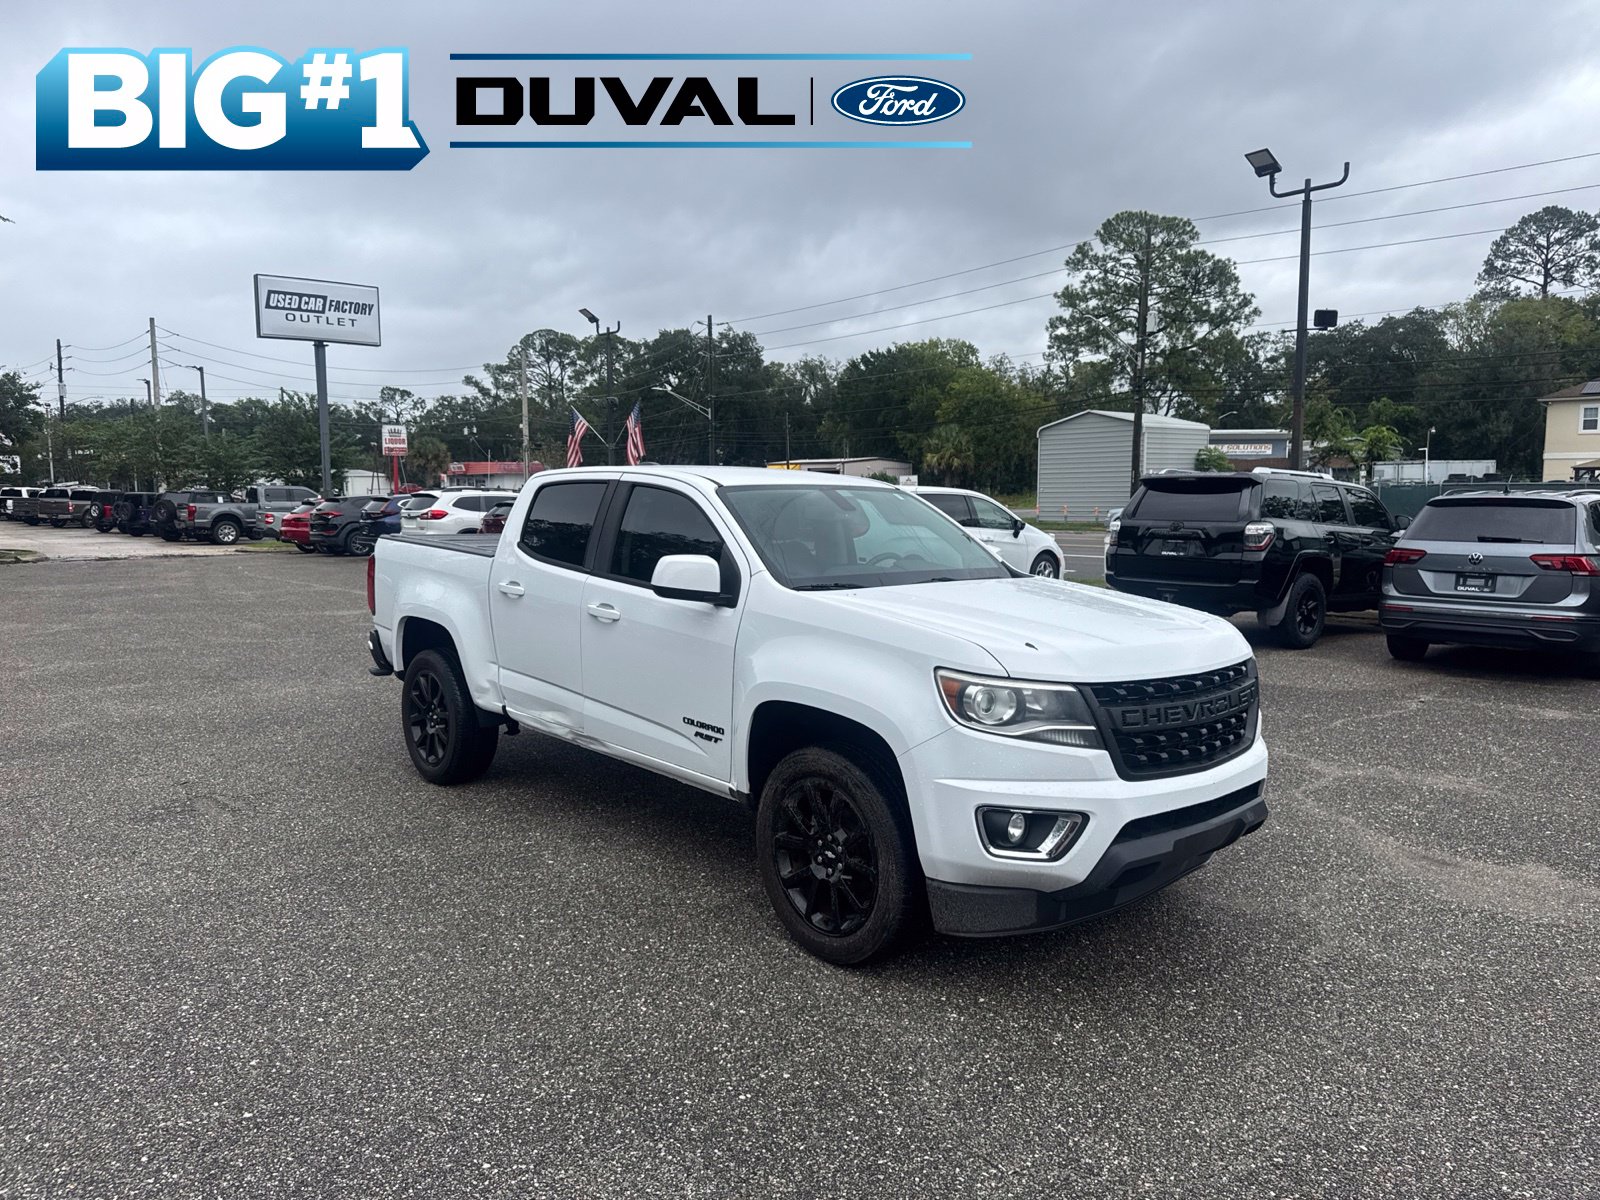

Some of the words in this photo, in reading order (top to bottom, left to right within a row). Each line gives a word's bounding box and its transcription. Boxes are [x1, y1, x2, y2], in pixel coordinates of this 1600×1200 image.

[269, 293, 299, 309] USED
[300, 296, 324, 311] CAR
[327, 299, 375, 316] FACTORY
[285, 312, 358, 327] OUTLET
[384, 437, 406, 445] LIQUOR
[1121, 687, 1255, 729] CHEVROLET
[682, 716, 725, 736] COLORADO
[693, 730, 723, 744] RST
